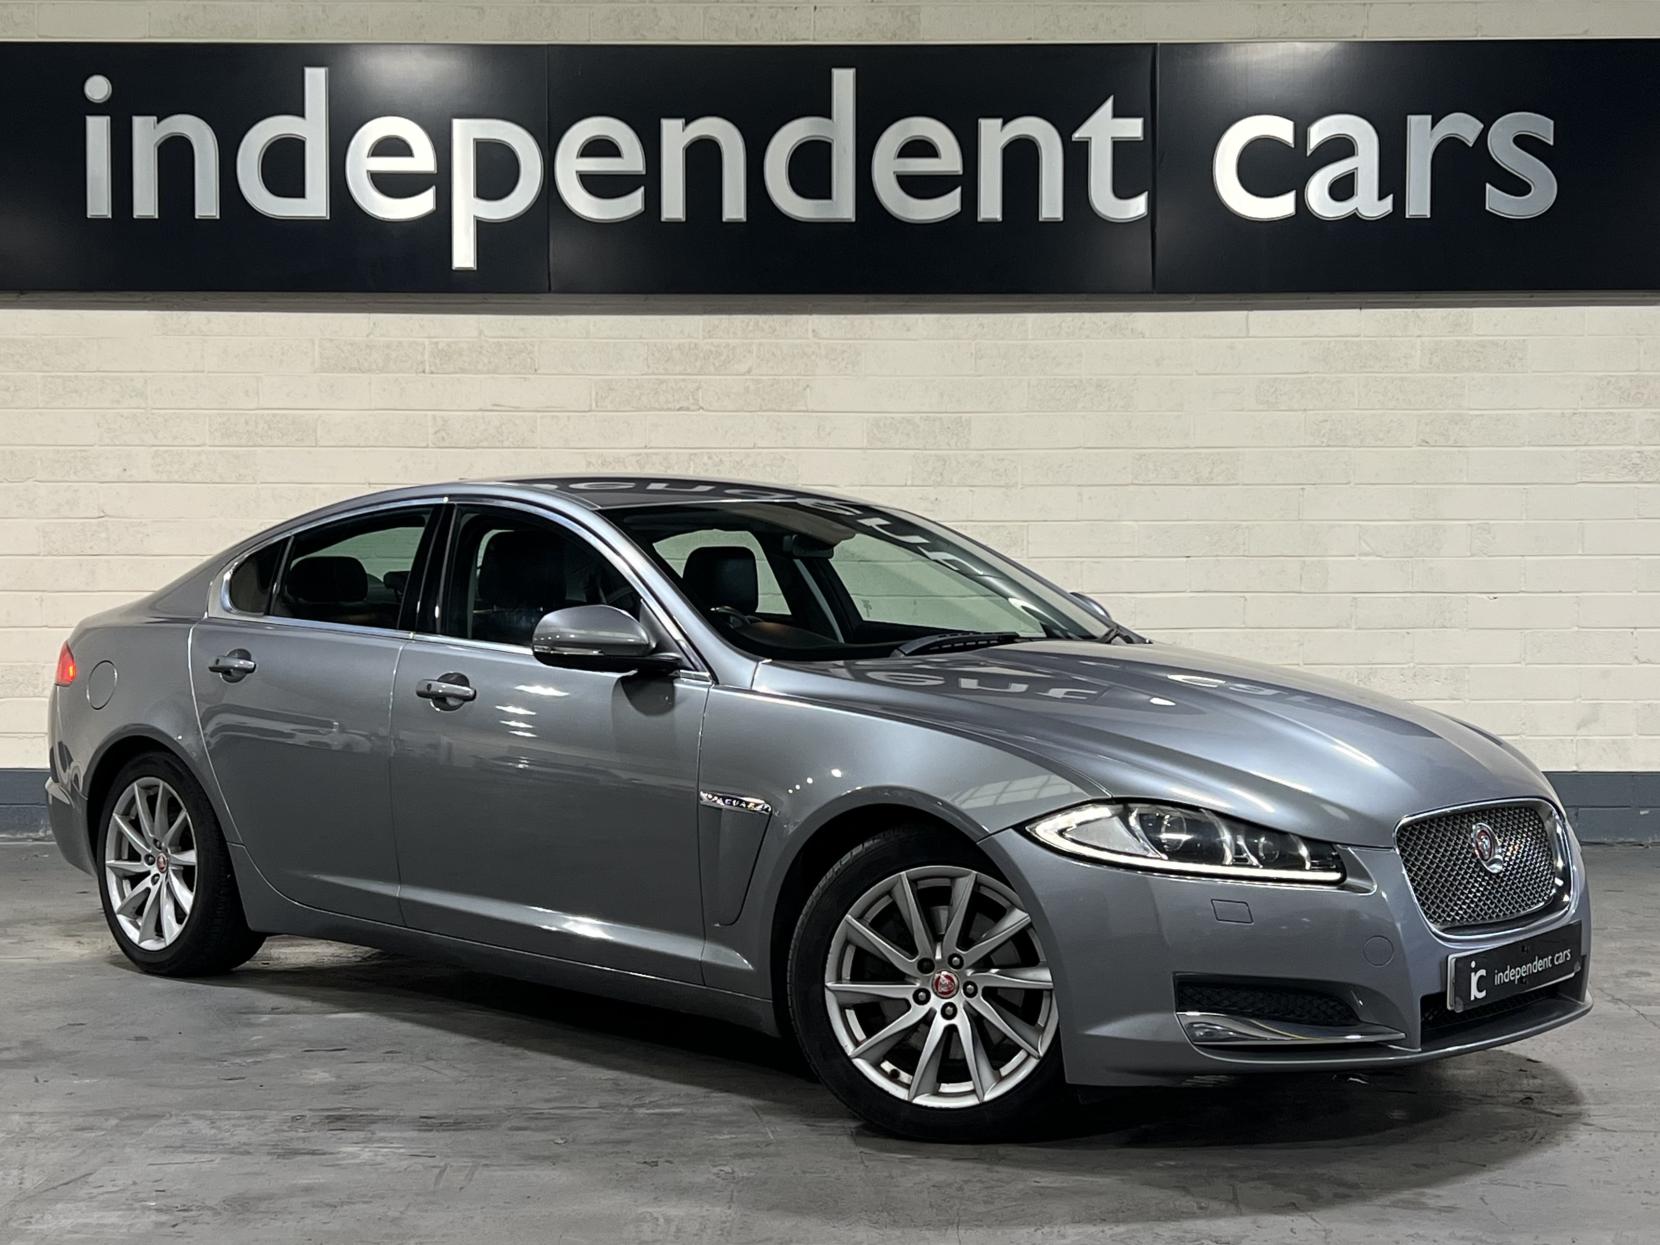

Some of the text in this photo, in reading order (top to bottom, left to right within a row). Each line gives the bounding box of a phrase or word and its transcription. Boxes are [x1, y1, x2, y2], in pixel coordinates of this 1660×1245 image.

[84, 67, 1558, 270] independent cars
[1494, 949, 1571, 986] independent cars
